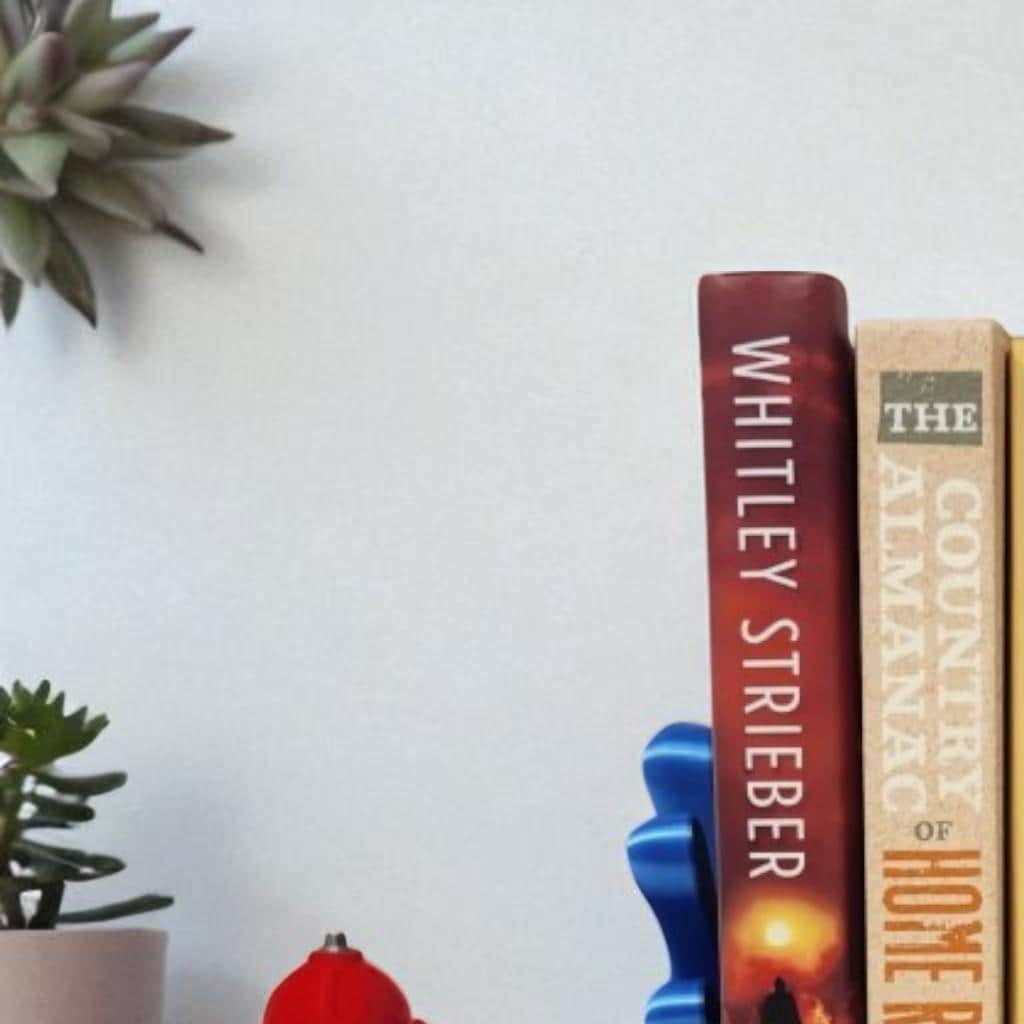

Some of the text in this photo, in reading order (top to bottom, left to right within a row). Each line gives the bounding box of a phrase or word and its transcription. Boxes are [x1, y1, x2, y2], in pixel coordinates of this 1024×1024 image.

[884, 402, 978, 433] THE
[732, 335, 806, 880] WHITLEY STRIEBER
[879, 451, 927, 815] ALMANAC
[935, 476, 983, 816] COUNTRY
[882, 850, 983, 983] HOME
[914, 820, 953, 842] OF
